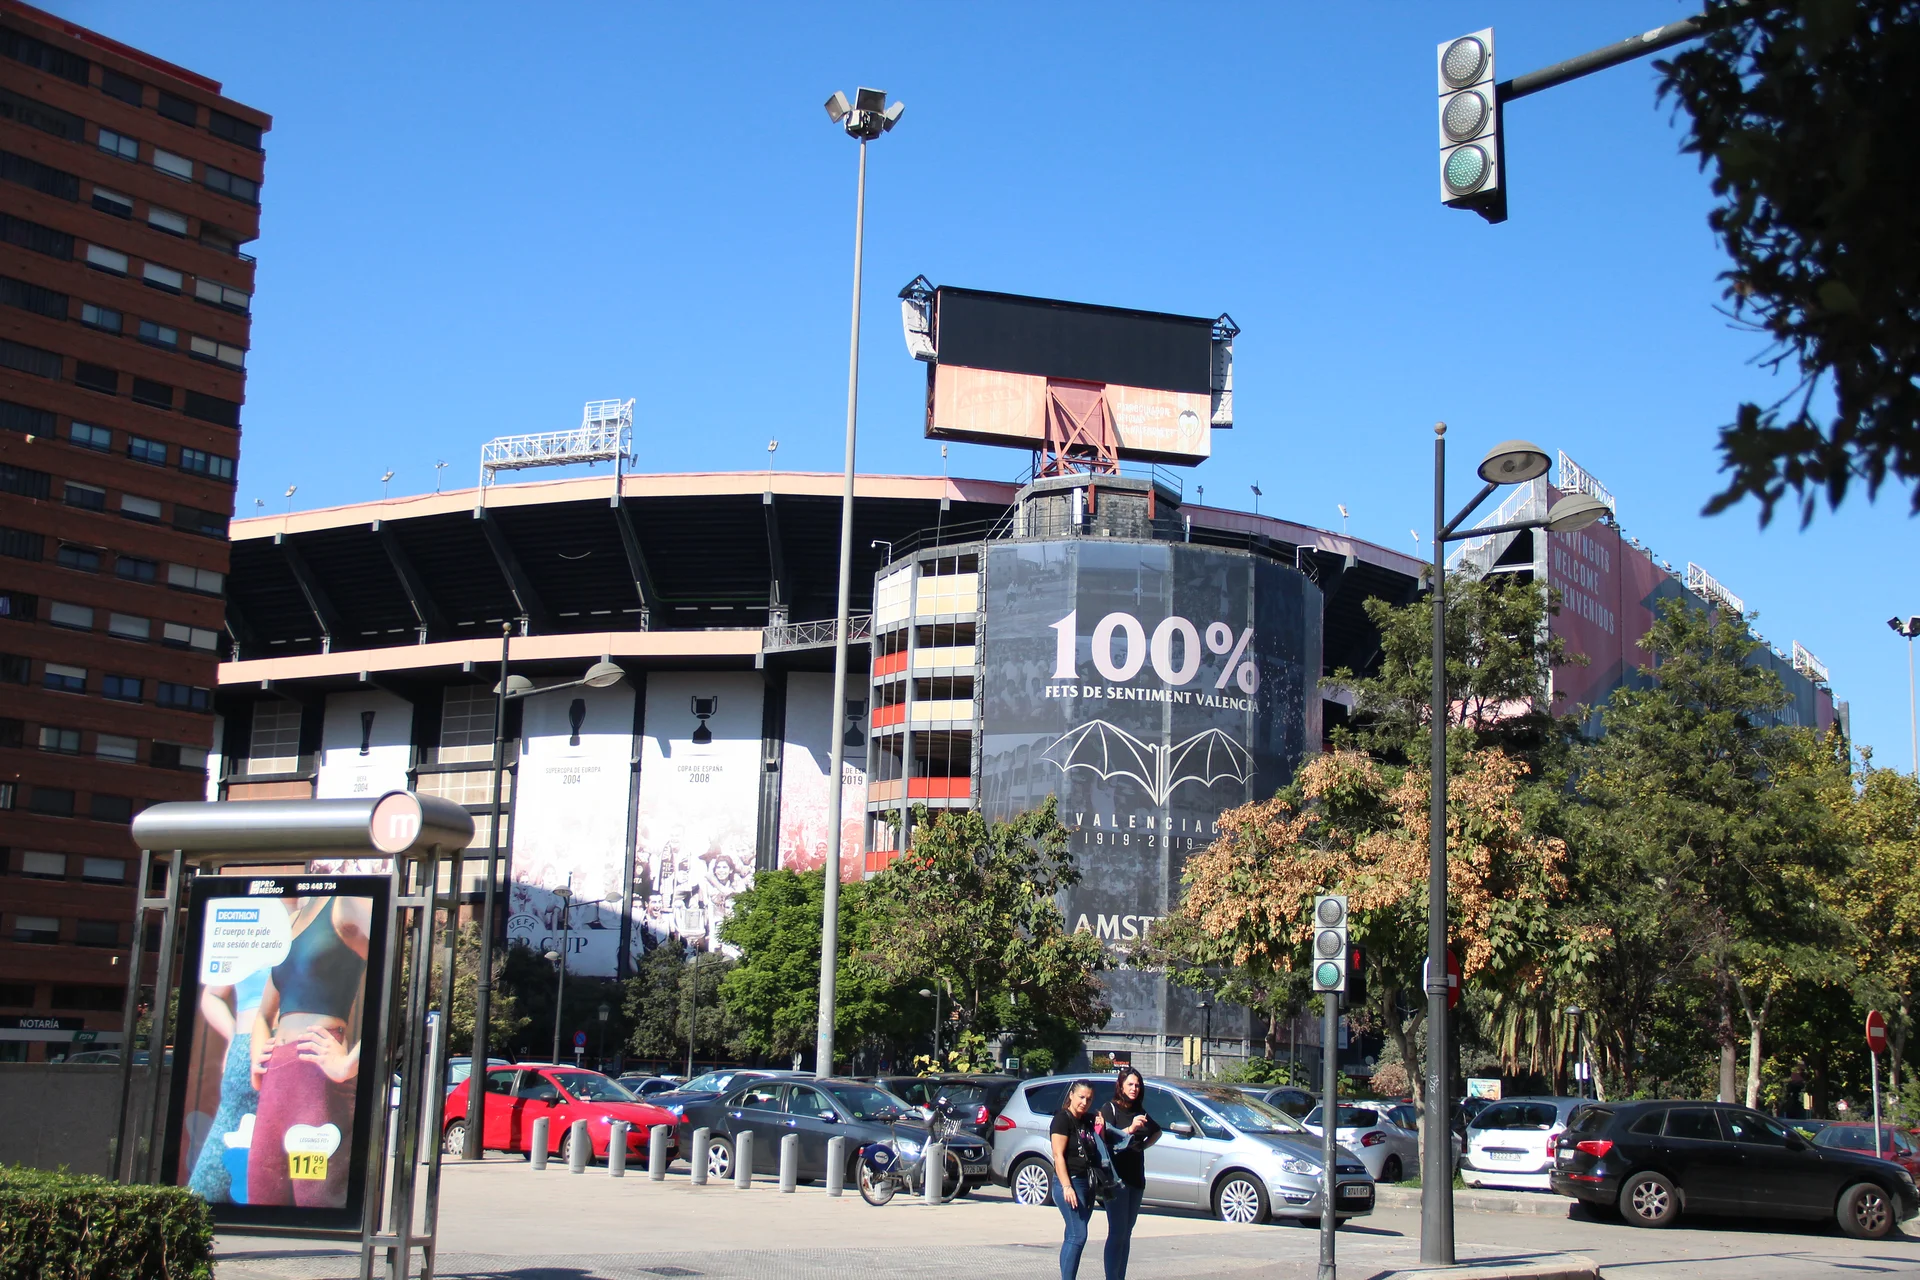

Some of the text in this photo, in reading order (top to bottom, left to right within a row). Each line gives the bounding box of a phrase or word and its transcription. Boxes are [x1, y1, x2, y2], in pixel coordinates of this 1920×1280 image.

[1554, 546, 1599, 595] WELCOME
[1048, 608, 1260, 695] 100%
[1045, 685, 1079, 698] FETS
[1083, 686, 1103, 699] DE
[1106, 687, 1192, 704] SENTIMENT
[702, 764, 723, 772] ESPAÑA
[563, 774, 581, 784] 2004
[689, 773, 710, 783] 2008
[842, 775, 863, 786] 2019
[218, 911, 258, 920] DECATHLON
[509, 918, 535, 930] UEFA
[214, 927, 271, 938] El cuerpo te pide
[227, 940, 250, 949] sesión
[251, 940, 260, 949] de
[261, 940, 283, 949] cardio
[20, 1018, 60, 1029] NOTARÍA
